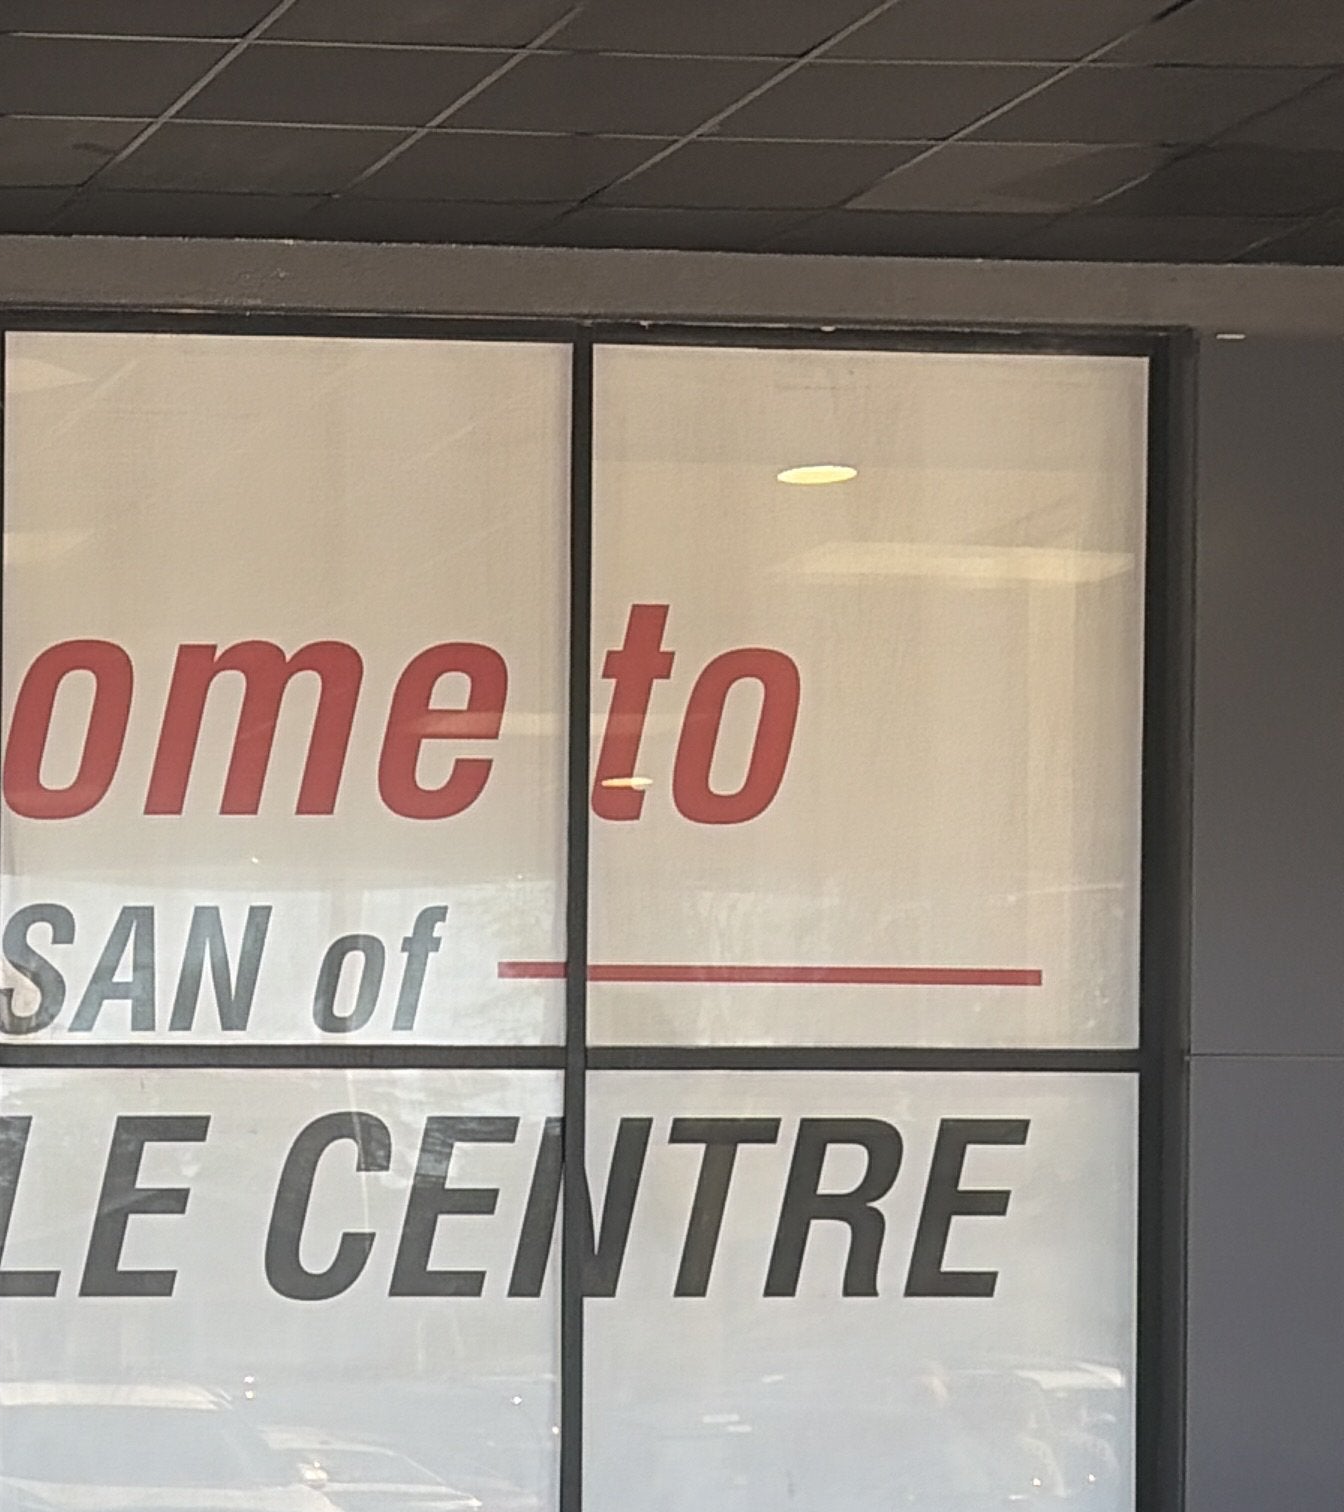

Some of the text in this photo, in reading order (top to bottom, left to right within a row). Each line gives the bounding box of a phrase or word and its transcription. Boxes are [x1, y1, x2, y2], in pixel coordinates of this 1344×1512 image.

[593, 603, 801, 825] to
[313, 904, 449, 1033] of
[263, 1113, 1030, 1302] CENTRE
